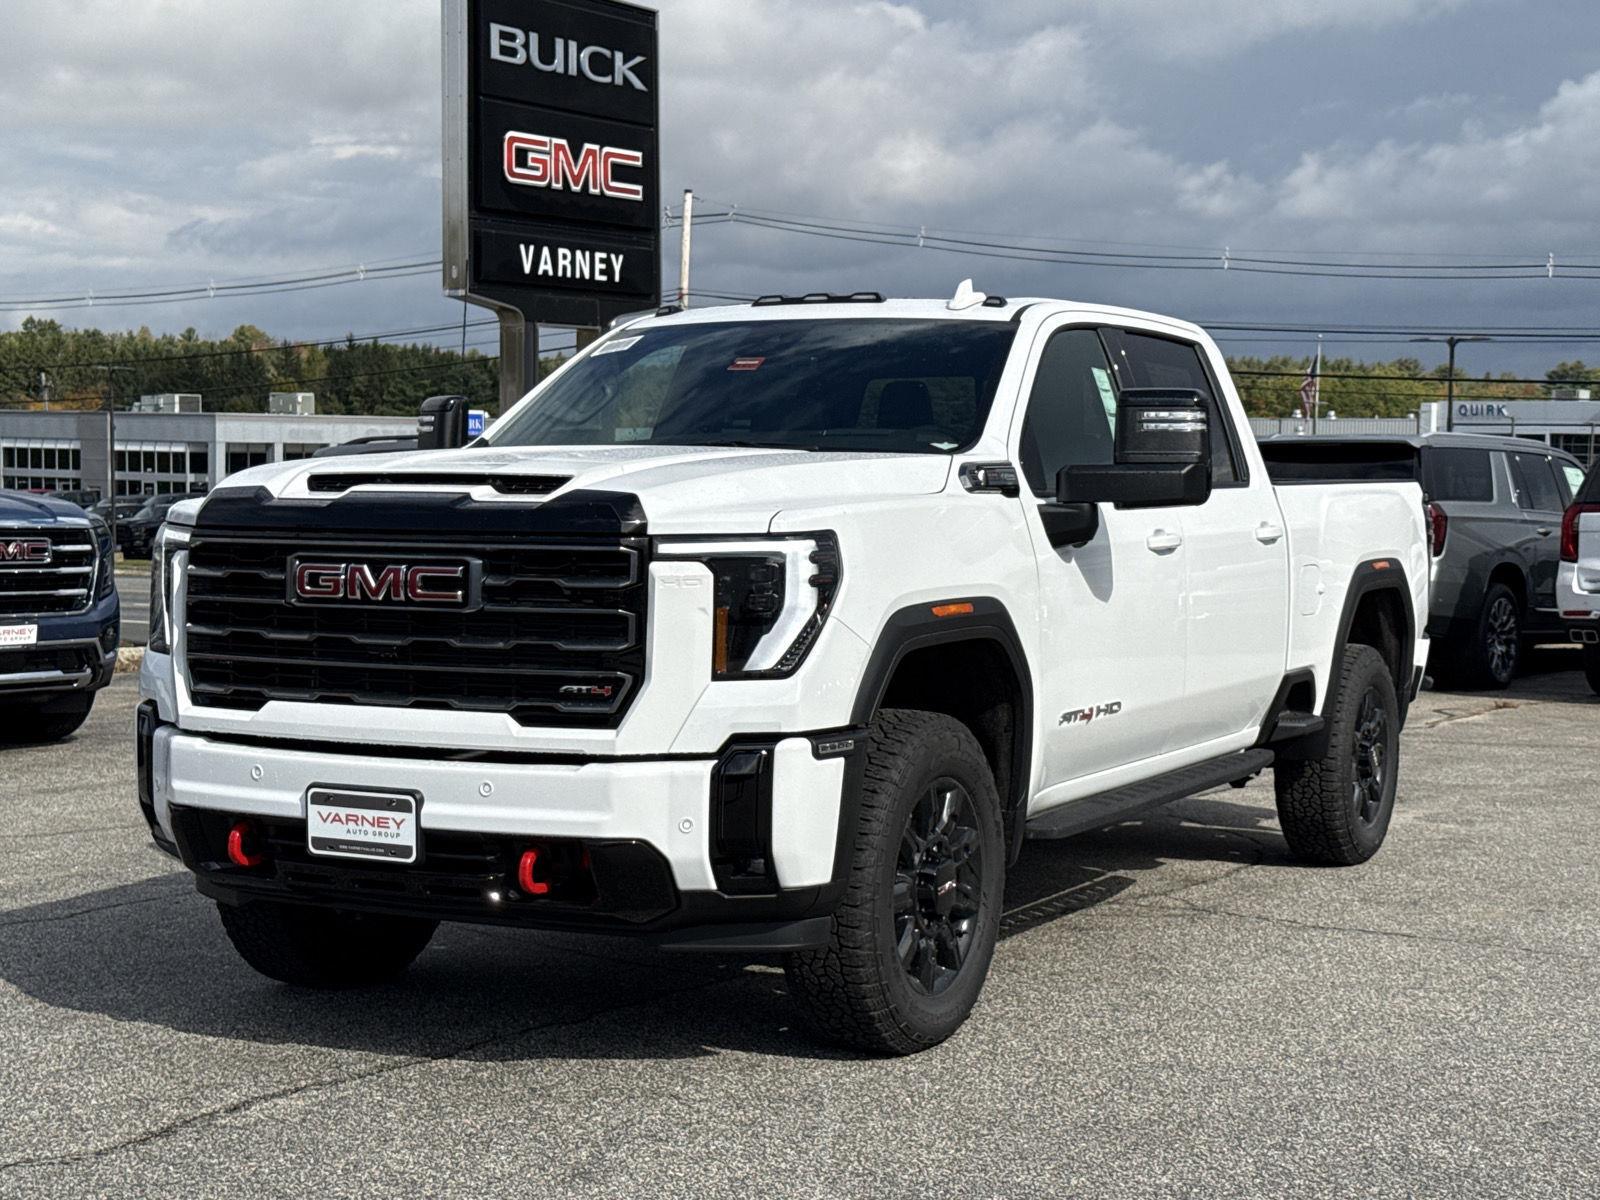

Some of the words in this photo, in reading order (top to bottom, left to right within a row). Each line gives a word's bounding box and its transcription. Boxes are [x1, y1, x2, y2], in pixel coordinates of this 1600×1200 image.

[489, 22, 648, 92] BUICK
[503, 130, 643, 201] GMC
[519, 243, 624, 283] VARNEY
[1458, 404, 1507, 417] QUIRK
[296, 563, 464, 602] GMC
[1096, 701, 1122, 718] HD
[317, 811, 405, 829] VARNEY
[346, 828, 369, 836] AUTO
[372, 830, 401, 838] GROUP
